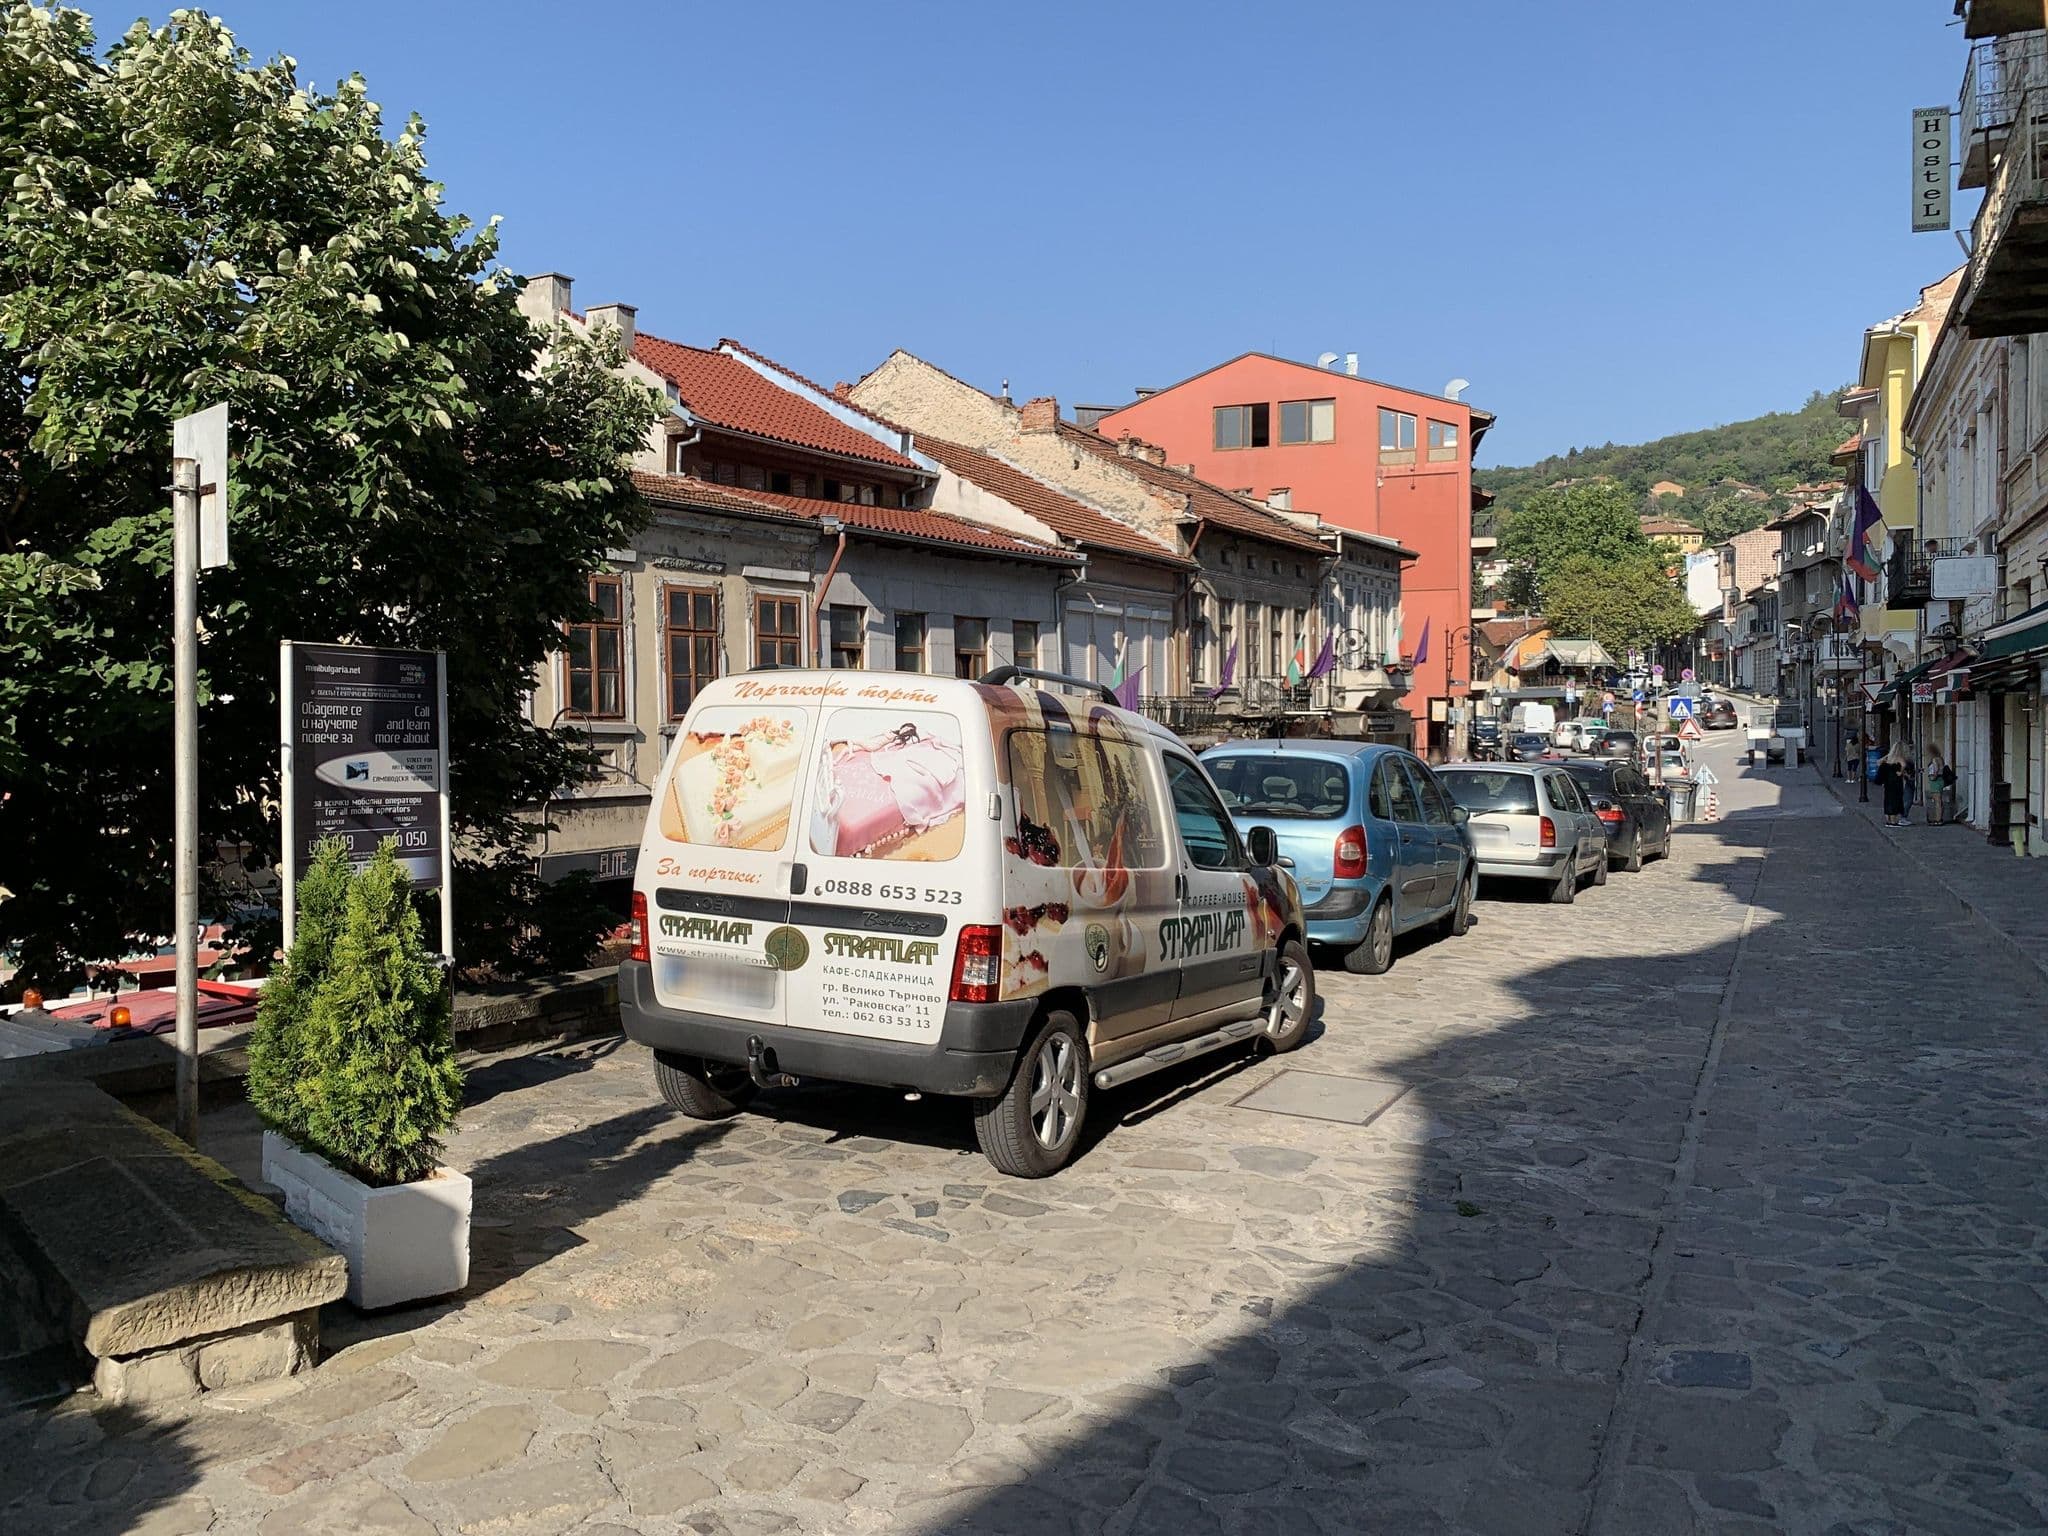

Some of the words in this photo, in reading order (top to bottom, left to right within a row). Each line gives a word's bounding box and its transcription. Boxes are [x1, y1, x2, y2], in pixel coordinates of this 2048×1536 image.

[305, 664, 361, 675] minibulgaria.net
[733, 680, 849, 700] Поръчкови
[857, 684, 939, 704] торти
[302, 702, 348, 718] Обадете
[350, 705, 362, 716] се
[414, 706, 430, 717] Call
[302, 719, 309, 729] и
[310, 719, 358, 732] научете
[386, 719, 404, 730] and
[406, 719, 430, 730] learn
[302, 733, 339, 744] повече
[341, 733, 353, 744] за
[375, 733, 401, 744] more
[402, 732, 430, 744] about
[325, 808, 337, 816] for
[350, 807, 374, 815] mobile
[376, 805, 411, 816] operators
[384, 796, 422, 805] оператори
[405, 831, 427, 846] 050
[599, 851, 628, 878] ELITE
[656, 857, 681, 876] За
[688, 867, 762, 884] поръчки:
[825, 879, 873, 897] 0888
[879, 885, 917, 901] 653
[924, 889, 962, 905] 523
[659, 914, 753, 945] СТРАТИЛАТ
[862, 911, 930, 933] Berlingo
[1159, 909, 1246, 962] STRATILAT
[823, 932, 939, 966] STRATILAT
[823, 965, 935, 986] КАФЕ-СЛАДКАРНИЦА
[822, 983, 838, 993] гр.
[842, 983, 885, 997] Велико
[889, 989, 941, 1004] Търново
[822, 996, 840, 1006] ул.
[915, 1006, 930, 1016] 11
[822, 1008, 849, 1019] тел.:
[853, 1011, 875, 1023] 062
[878, 1014, 893, 1025] 63
[897, 1016, 912, 1027] 53
[916, 1019, 930, 1029] 13
